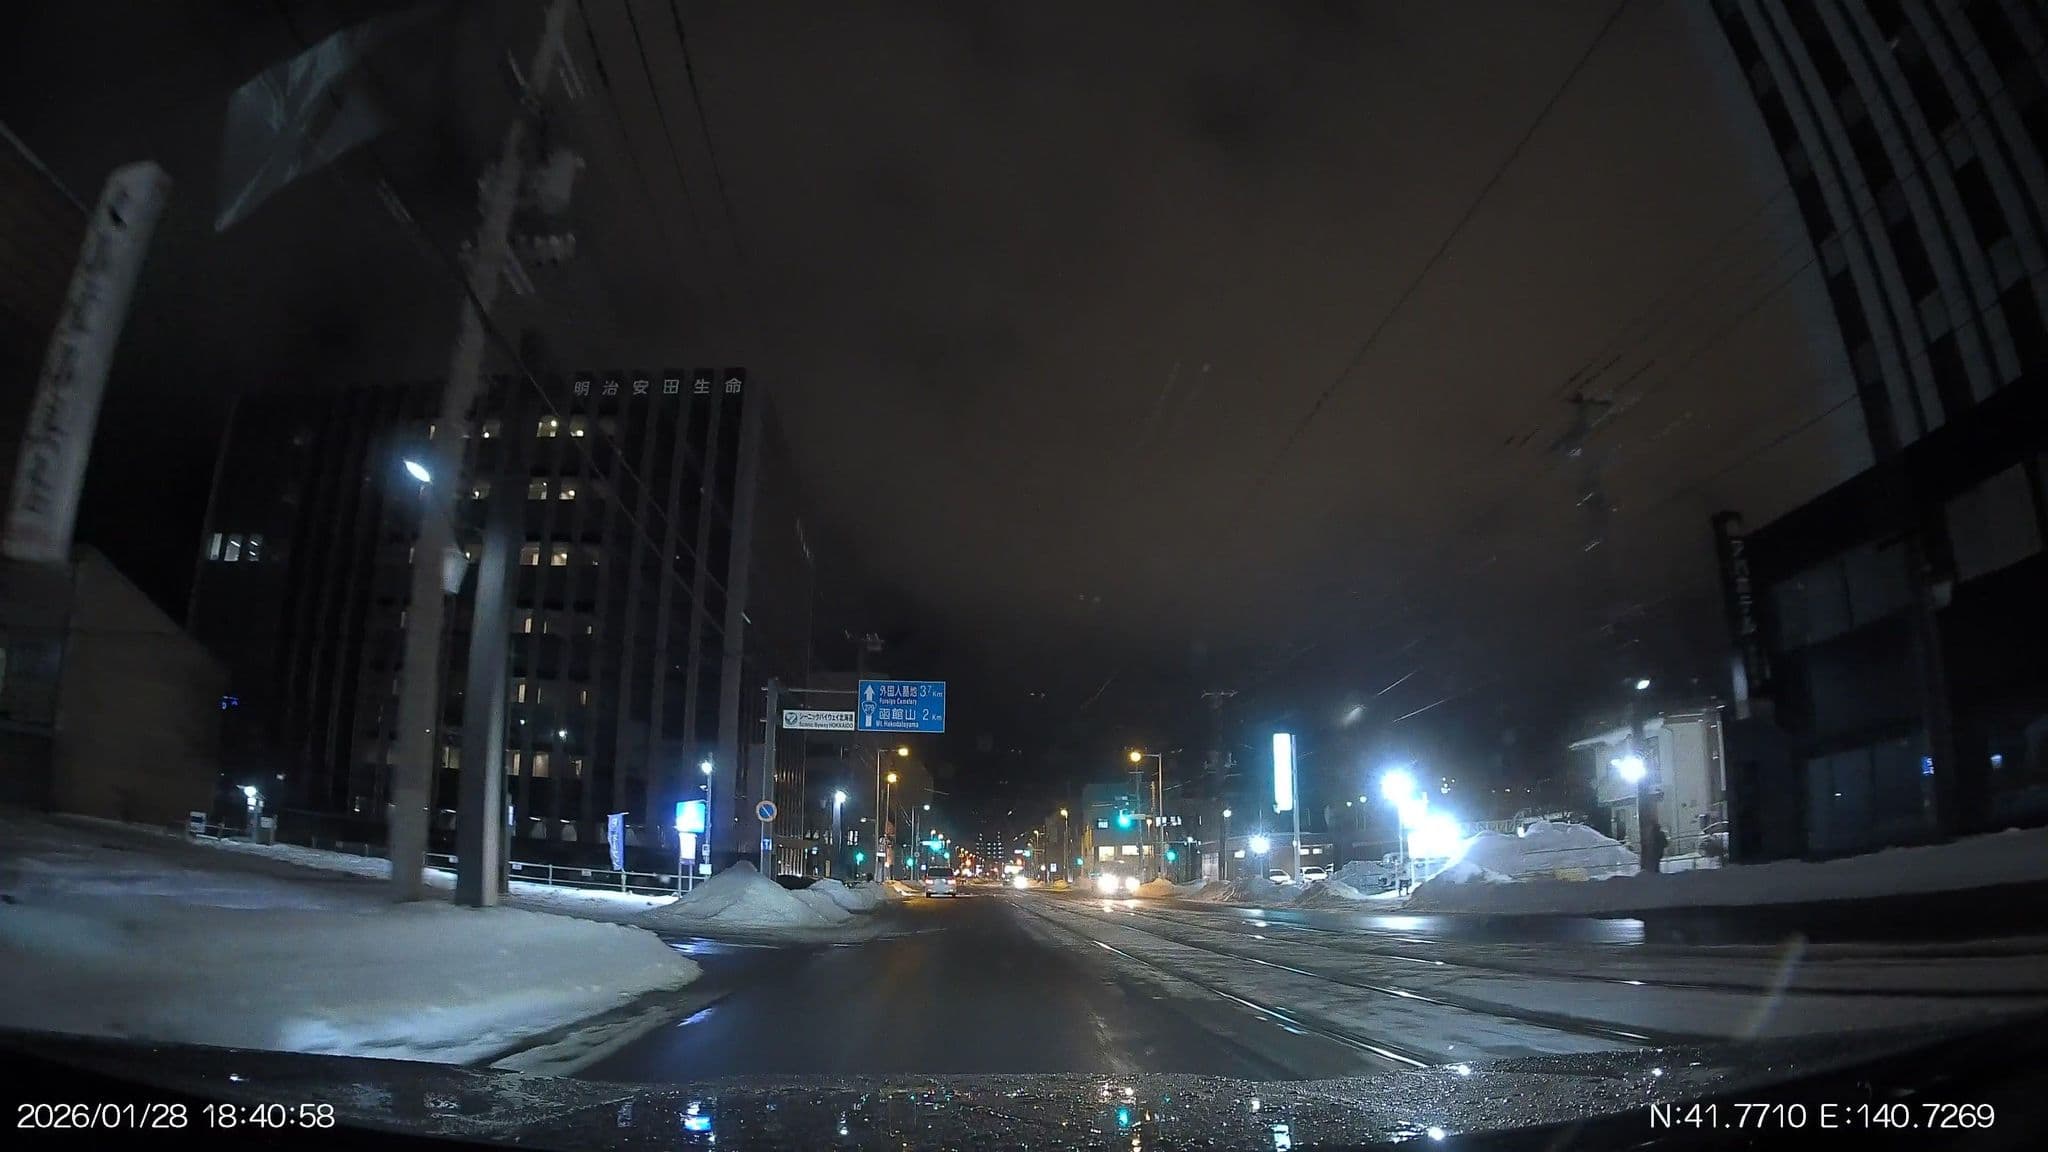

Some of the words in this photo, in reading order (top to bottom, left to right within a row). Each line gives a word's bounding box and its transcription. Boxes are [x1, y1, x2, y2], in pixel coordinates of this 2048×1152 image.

[574, 377, 742, 396] 明治安田生命
[879, 685, 918, 698] 外国人墓地
[879, 708, 916, 721] 函館山
[922, 708, 930, 721] 2
